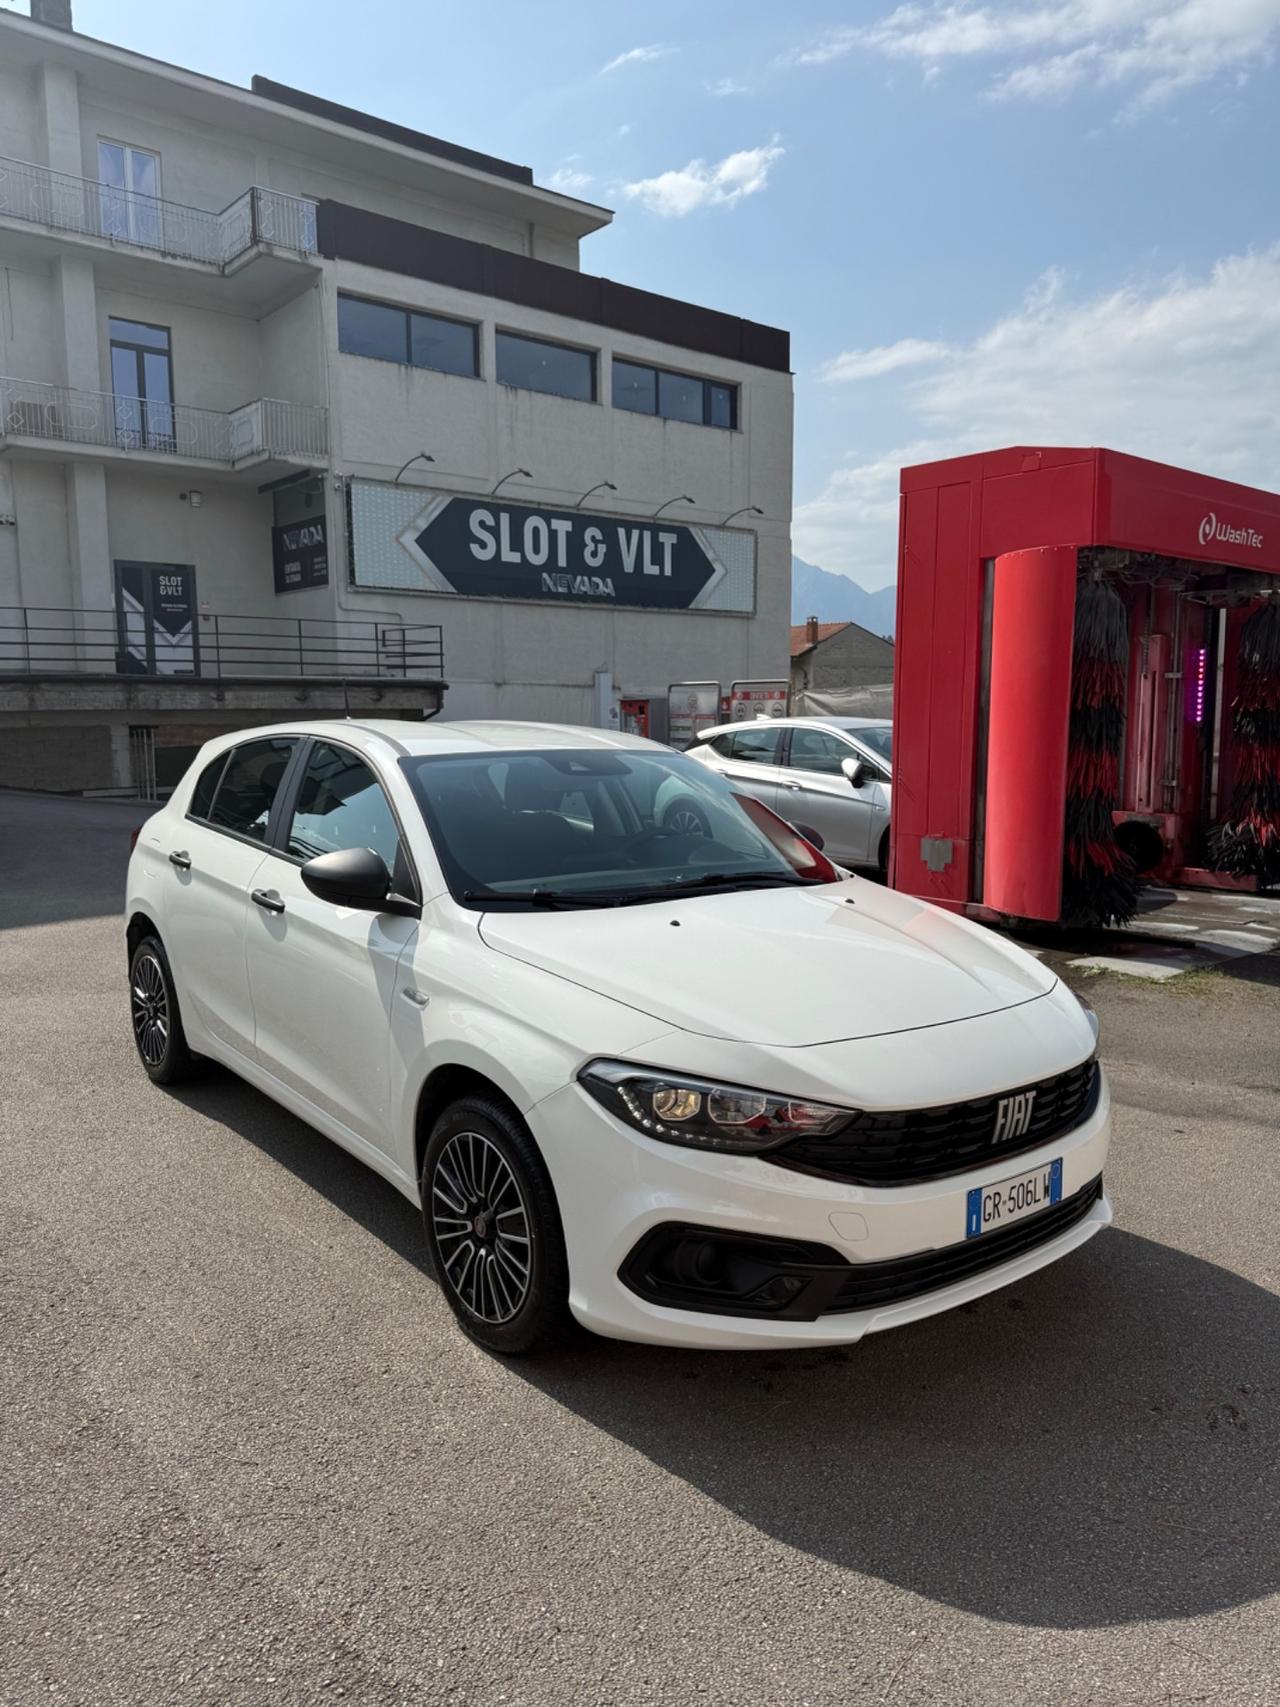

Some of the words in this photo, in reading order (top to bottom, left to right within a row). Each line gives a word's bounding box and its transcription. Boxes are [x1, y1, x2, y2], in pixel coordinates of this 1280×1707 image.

[469, 508, 572, 567] SLOT
[583, 526, 607, 567] &
[617, 527, 677, 576] VLT
[1216, 523, 1263, 548] WashTec
[159, 576, 182, 586] SLOT
[541, 573, 615, 597] NEVADA
[991, 1091, 1037, 1144] FIAT
